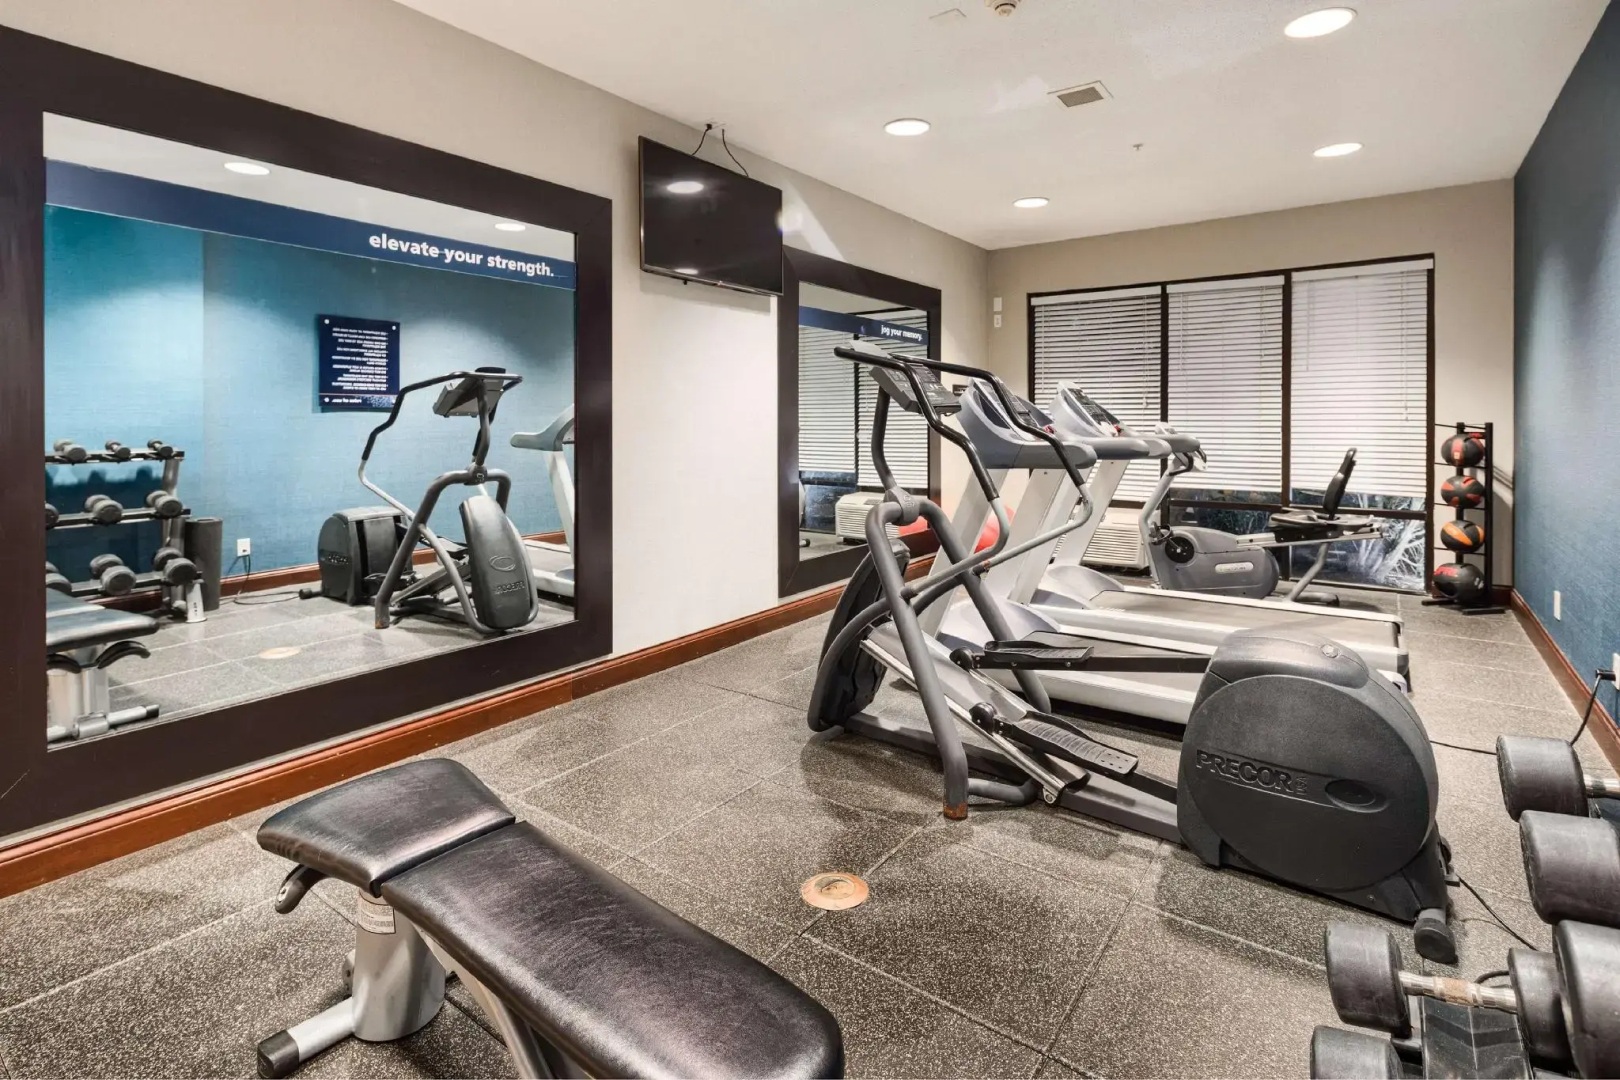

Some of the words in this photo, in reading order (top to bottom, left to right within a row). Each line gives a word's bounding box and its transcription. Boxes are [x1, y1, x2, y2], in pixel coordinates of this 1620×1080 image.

[368, 233, 440, 258] elevate
[443, 248, 484, 264] your
[486, 255, 556, 277] strength.
[881, 325, 890, 336] jog
[890, 328, 902, 337] your
[1196, 749, 1294, 793] PRECOR
